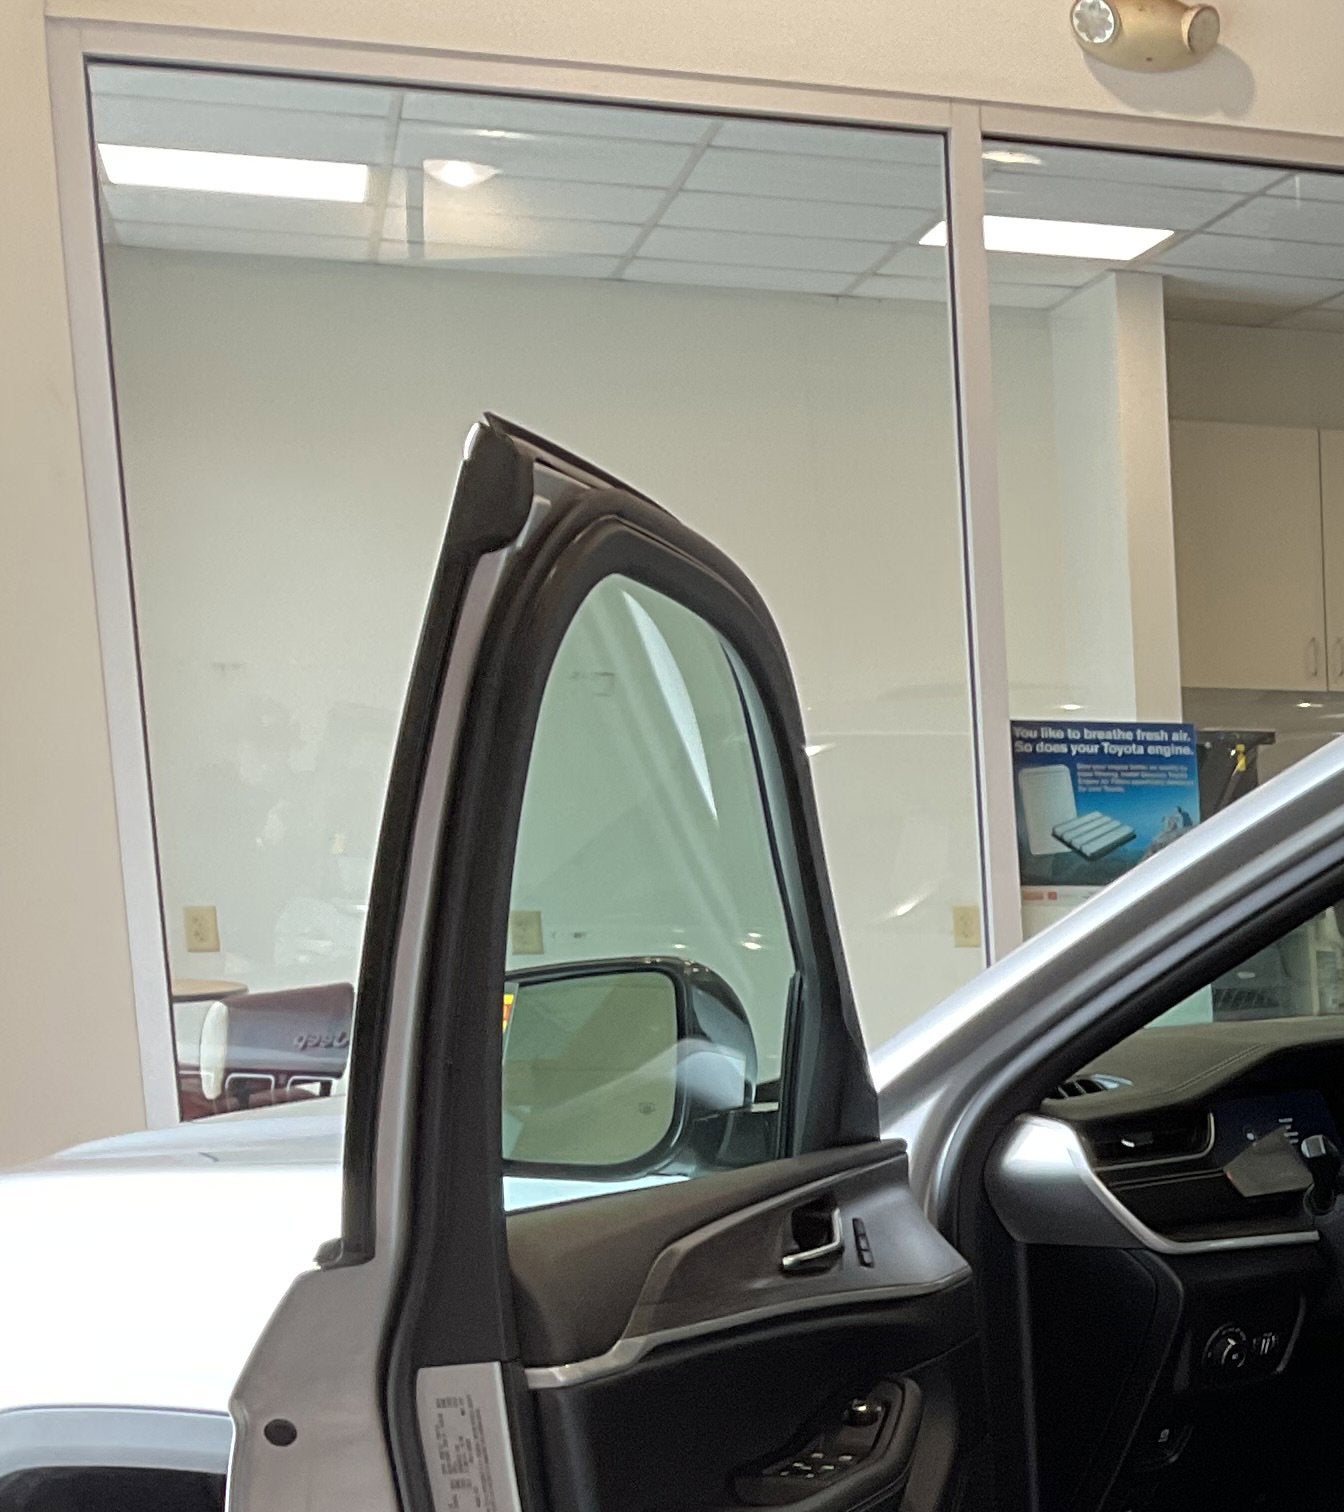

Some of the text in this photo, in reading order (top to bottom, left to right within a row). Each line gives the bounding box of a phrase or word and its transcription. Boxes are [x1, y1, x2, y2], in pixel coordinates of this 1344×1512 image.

[1012, 727, 1038, 739] You
[1041, 726, 1065, 739] like
[1067, 728, 1081, 740] to
[1084, 728, 1133, 741] breathe
[1136, 729, 1168, 741] fresh
[1014, 740, 1194, 758] So does your Toyota engine.
